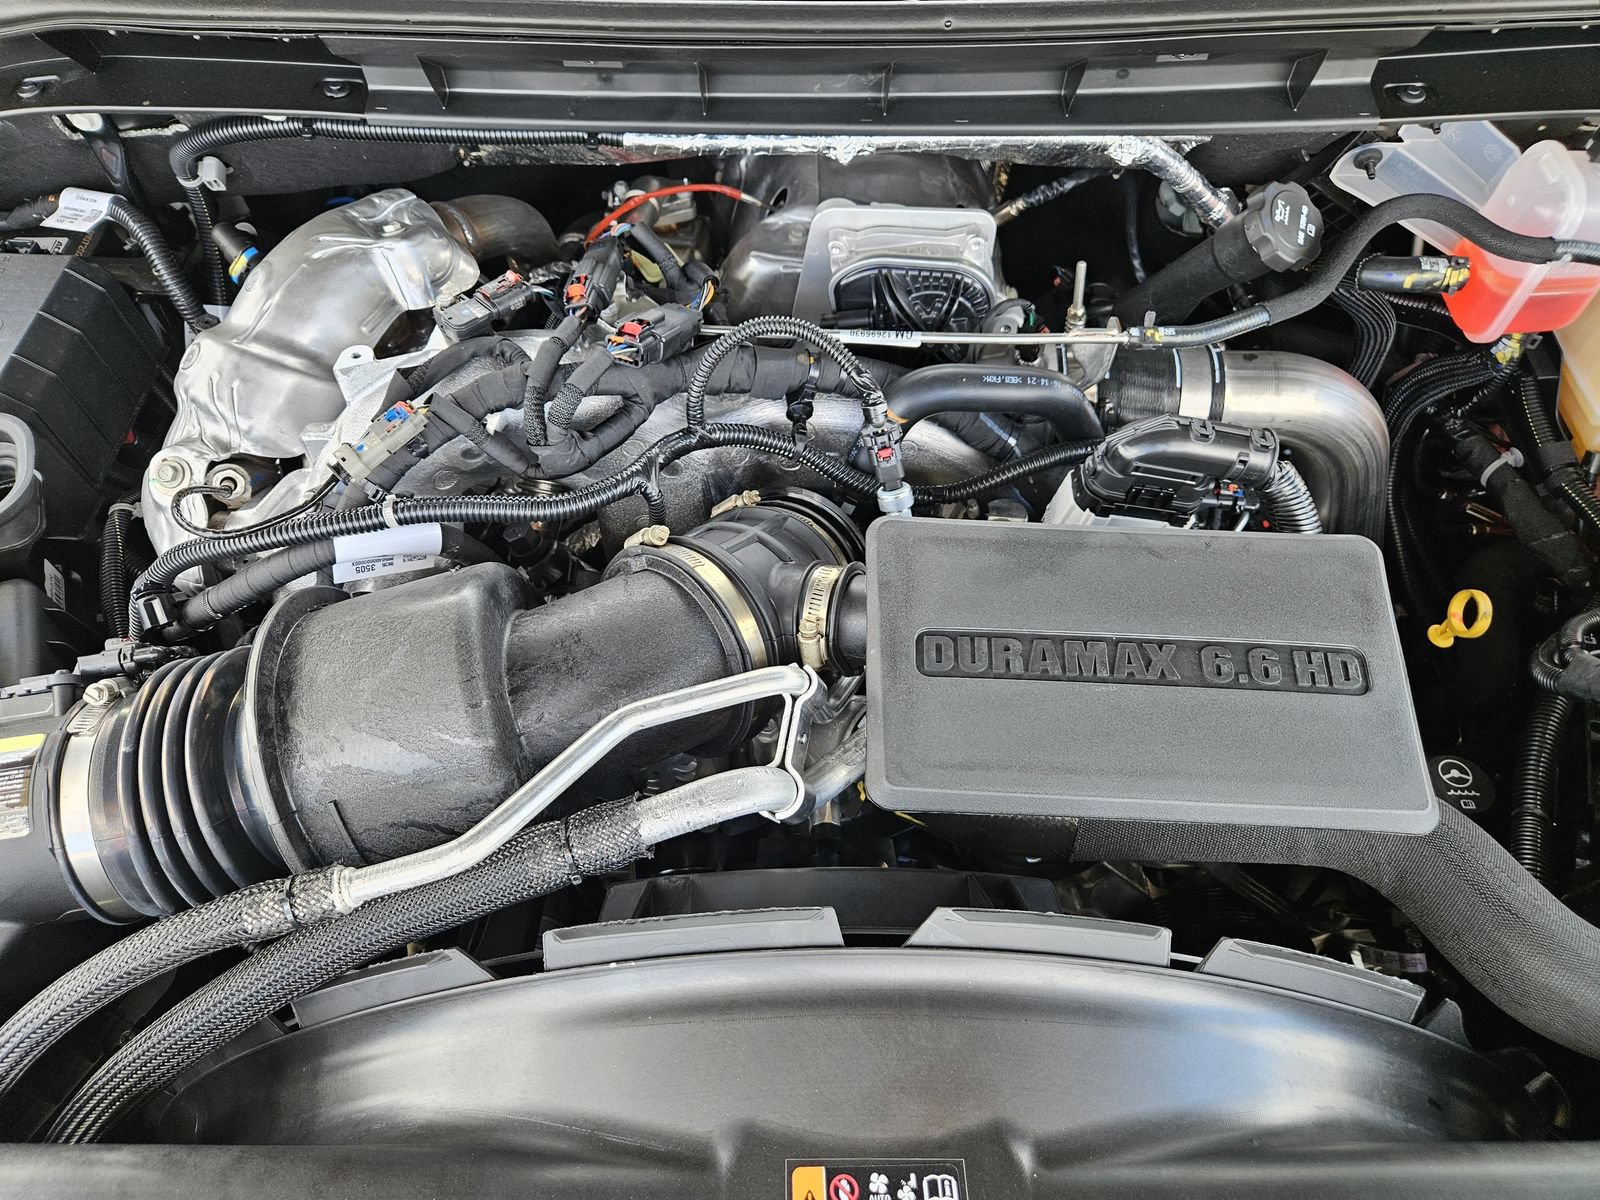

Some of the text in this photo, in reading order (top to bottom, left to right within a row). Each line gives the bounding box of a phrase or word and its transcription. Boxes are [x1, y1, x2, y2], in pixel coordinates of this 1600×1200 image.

[895, 330, 914, 340] GM
[355, 563, 376, 574] 3505
[923, 635, 1364, 690] DURAMAX 6.6 HD
